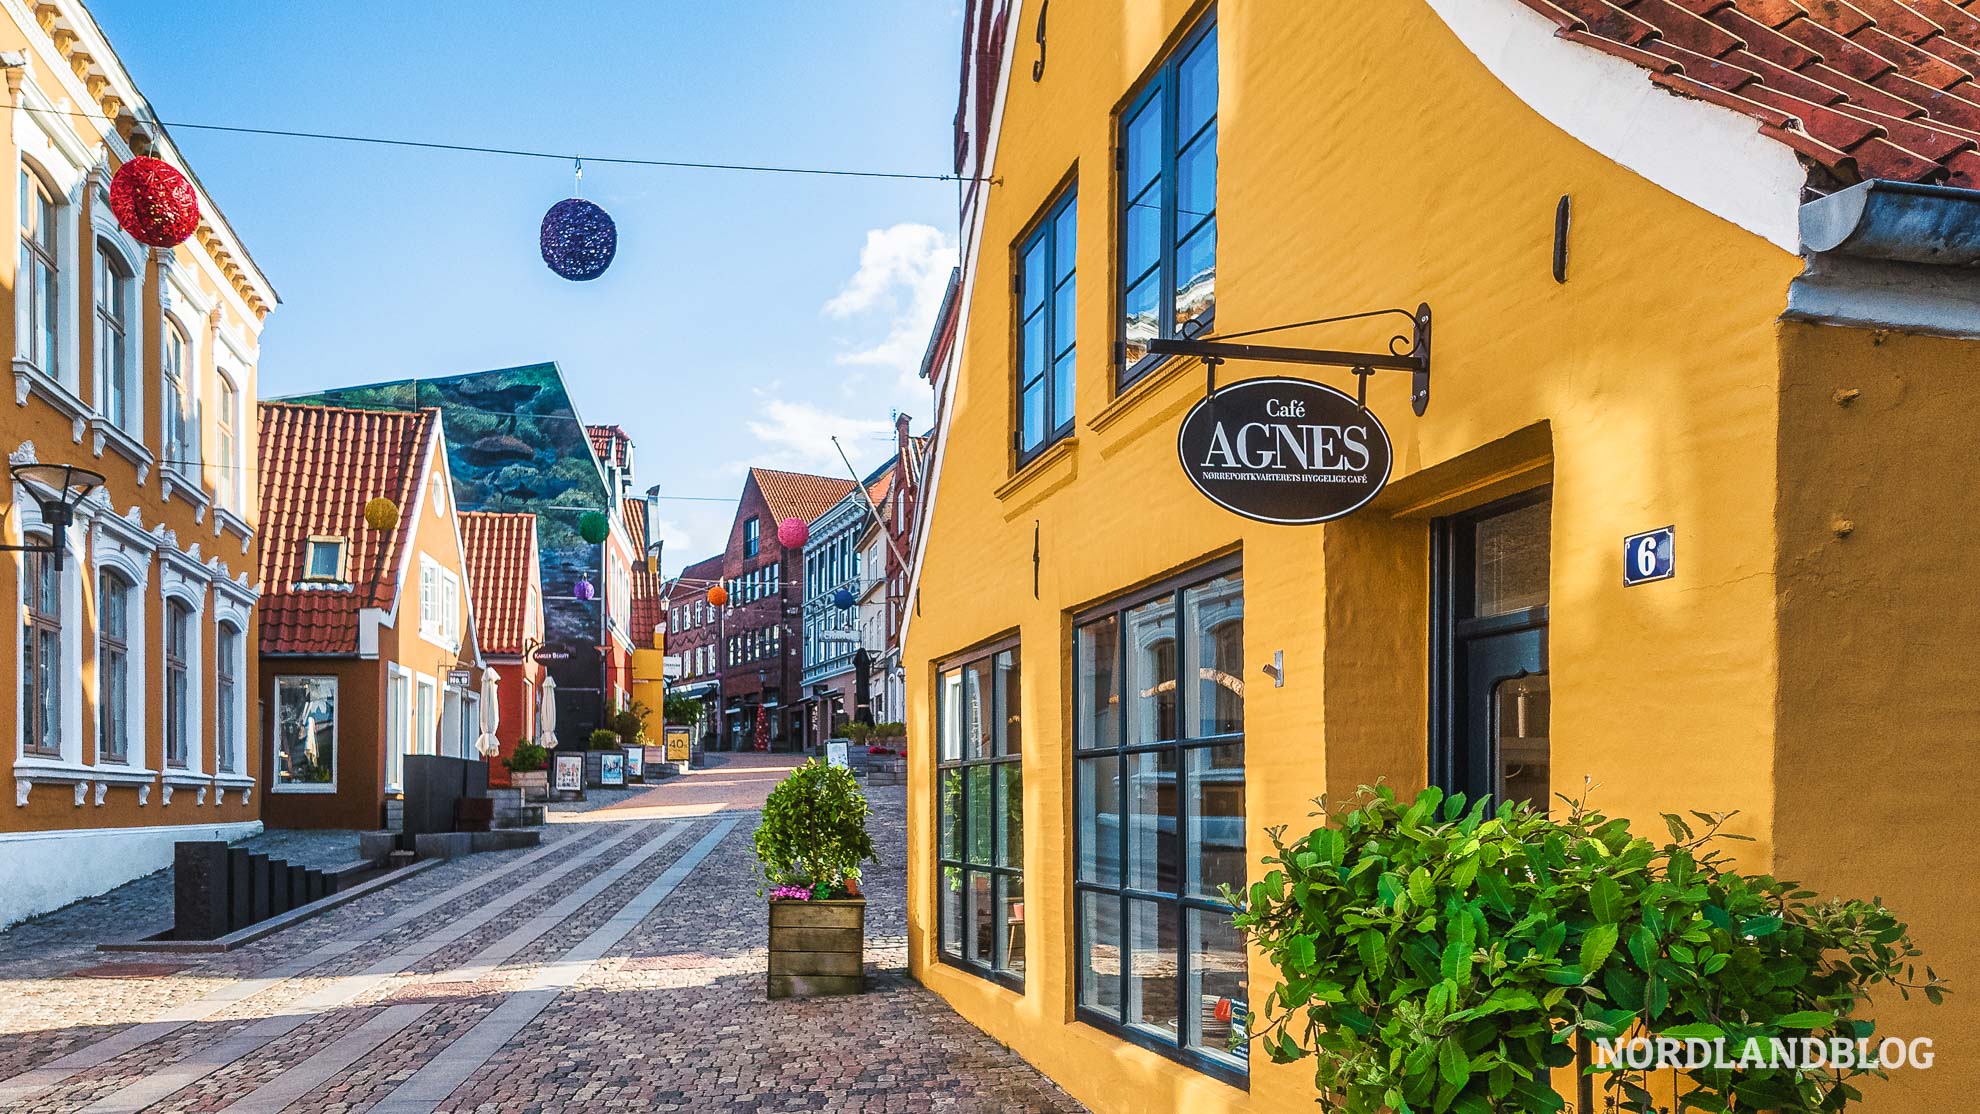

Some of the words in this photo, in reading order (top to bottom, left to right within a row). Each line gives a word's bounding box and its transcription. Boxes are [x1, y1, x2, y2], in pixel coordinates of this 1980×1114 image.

[1266, 398, 1306, 418] Café
[1200, 421, 1370, 472] AGNES
[1202, 471, 1300, 482] NØRREPORTKVARTERETS
[1301, 473, 1347, 484] HYGGELIGE
[1347, 474, 1368, 484] CAFÉ
[1637, 536, 1657, 576] 6
